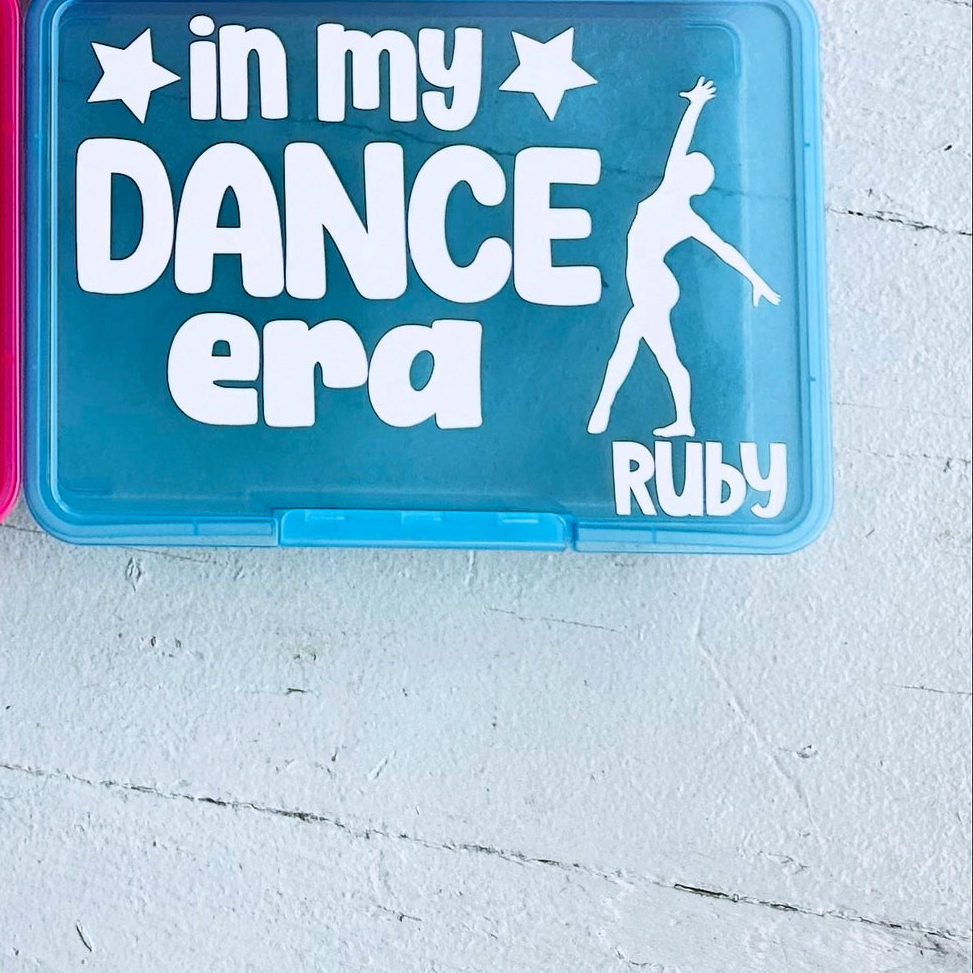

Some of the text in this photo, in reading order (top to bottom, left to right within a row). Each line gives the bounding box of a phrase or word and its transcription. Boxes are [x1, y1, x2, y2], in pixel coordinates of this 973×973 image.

[190, 16, 482, 130] in my
[77, 139, 601, 305] DANCE
[168, 313, 482, 428] era
